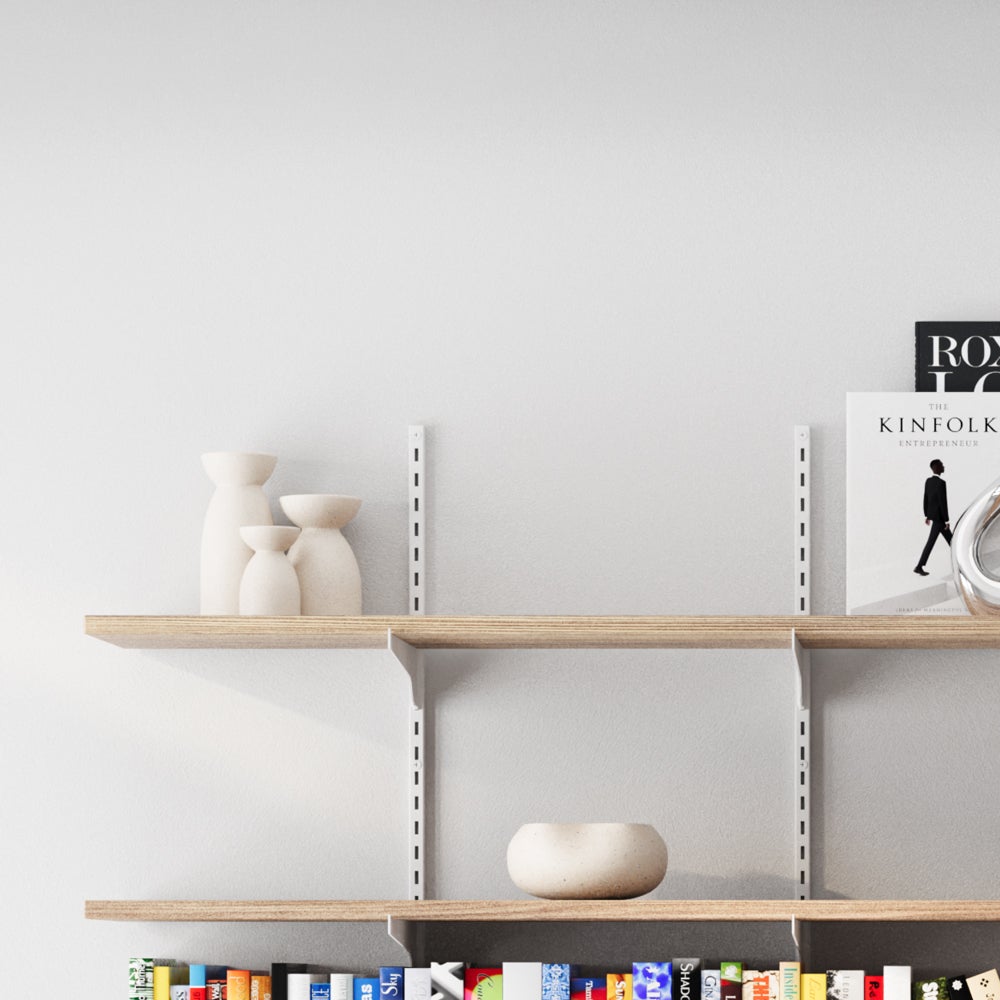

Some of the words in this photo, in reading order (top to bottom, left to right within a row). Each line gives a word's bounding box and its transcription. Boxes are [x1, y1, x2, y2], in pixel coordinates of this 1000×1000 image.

[928, 403, 949, 411] THE
[879, 417, 998, 433] KINFOLK
[381, 973, 400, 996] Sky
[783, 967, 797, 1000] Inside
[312, 988, 329, 1000] ICE
